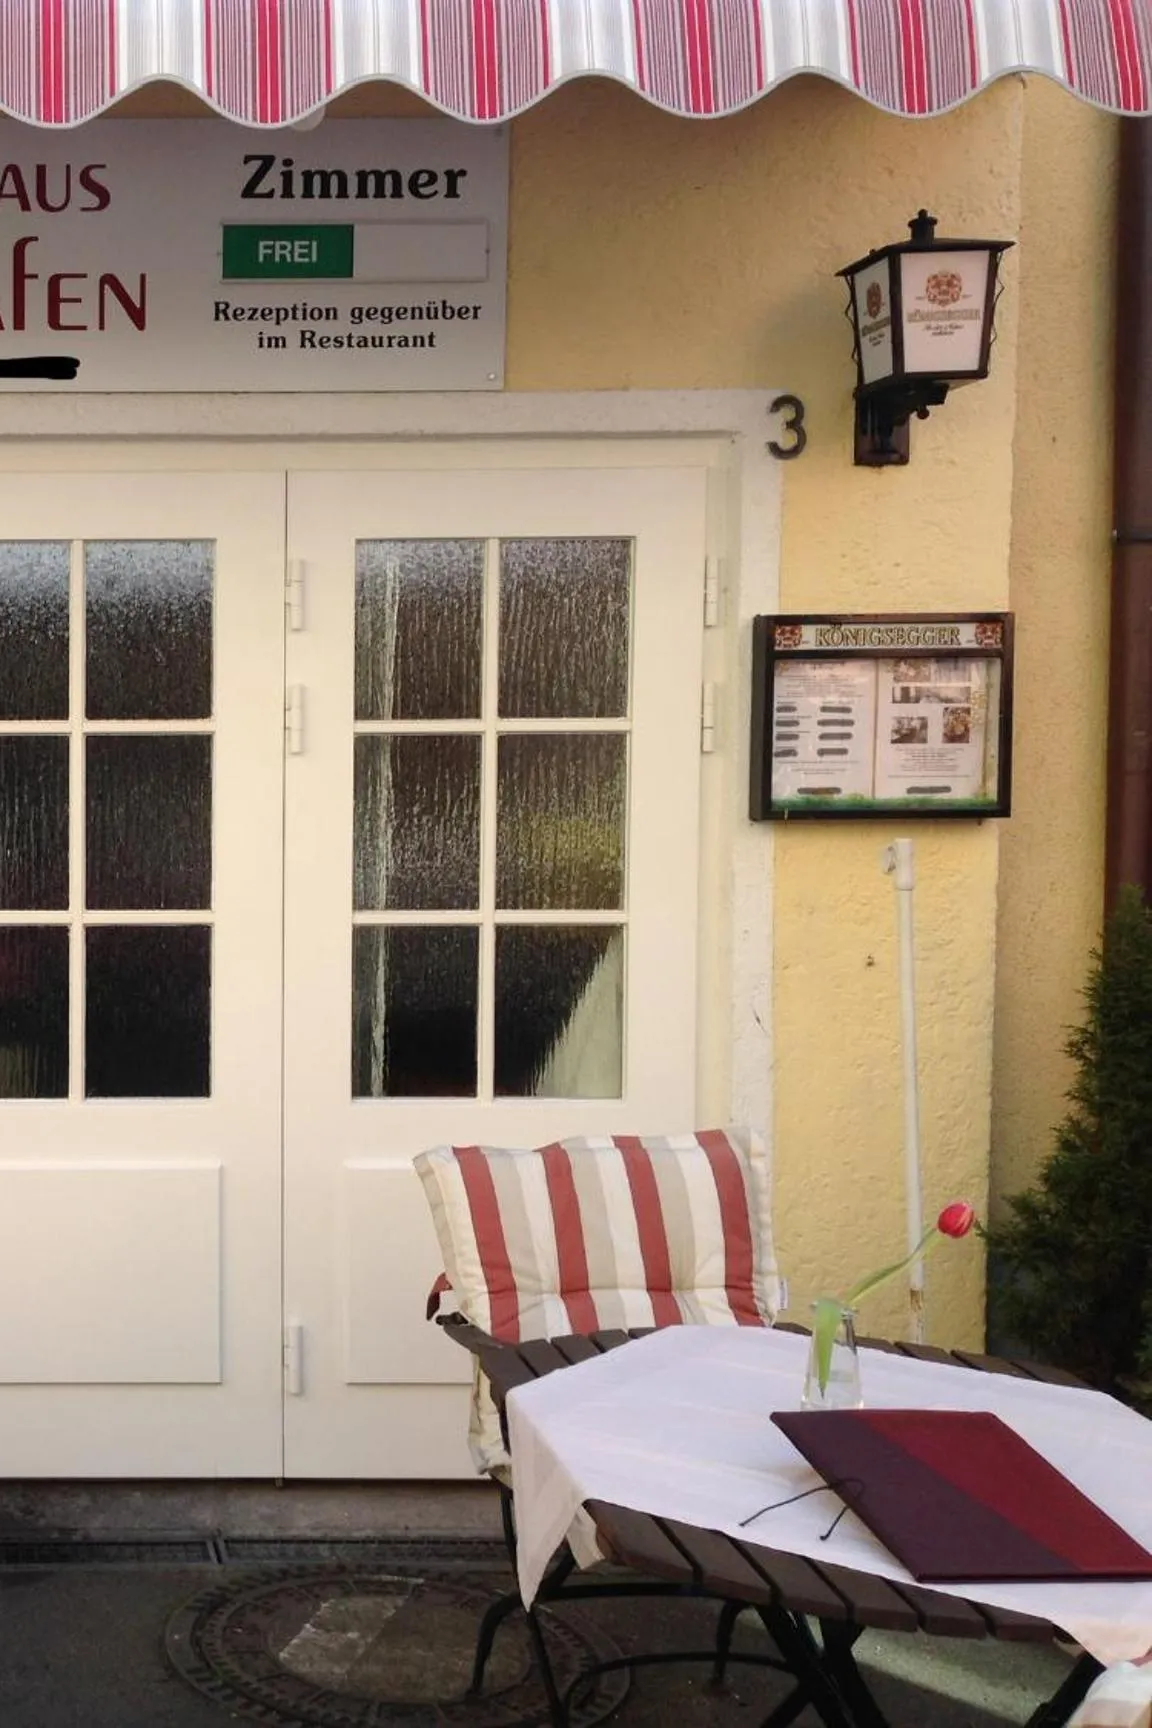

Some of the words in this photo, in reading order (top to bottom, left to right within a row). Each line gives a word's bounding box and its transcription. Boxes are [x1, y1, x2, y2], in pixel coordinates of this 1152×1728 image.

[240, 154, 468, 200] Zimmer
[258, 240, 318, 263] FREI
[213, 301, 339, 326] Rezeption
[350, 300, 482, 325] gegenüber
[258, 331, 287, 349] im
[300, 330, 437, 349] Restaurant
[767, 394, 807, 460] 3
[814, 624, 962, 648] KÖNIGSEGGER
